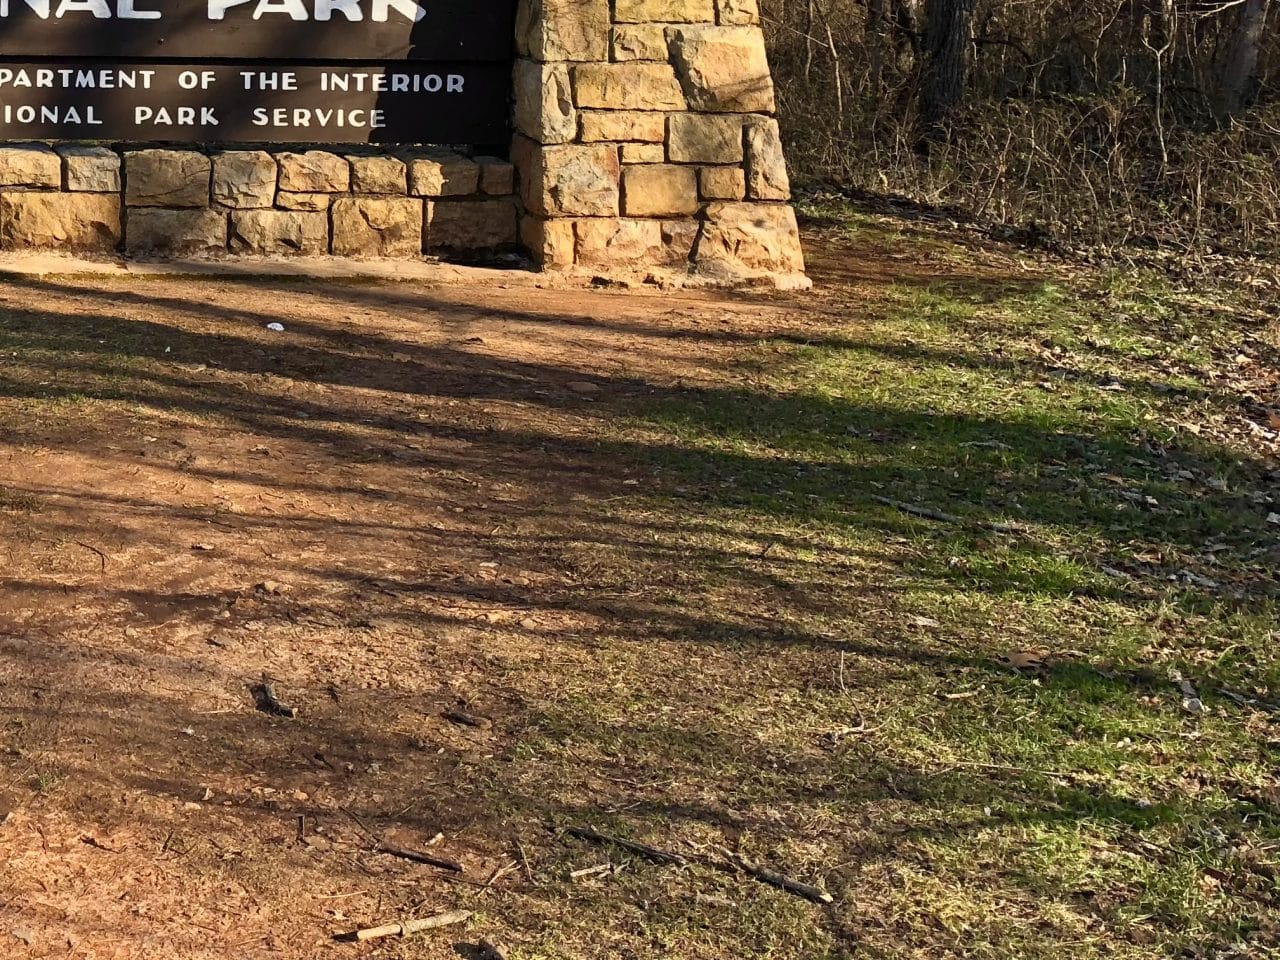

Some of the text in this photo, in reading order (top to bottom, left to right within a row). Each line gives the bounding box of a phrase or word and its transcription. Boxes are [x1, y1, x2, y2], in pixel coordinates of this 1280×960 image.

[177, 70, 216, 90] OF
[239, 71, 298, 91] THE
[320, 72, 465, 93] INTERIOR
[134, 106, 219, 126] PARK
[251, 107, 386, 128] SERVICE
